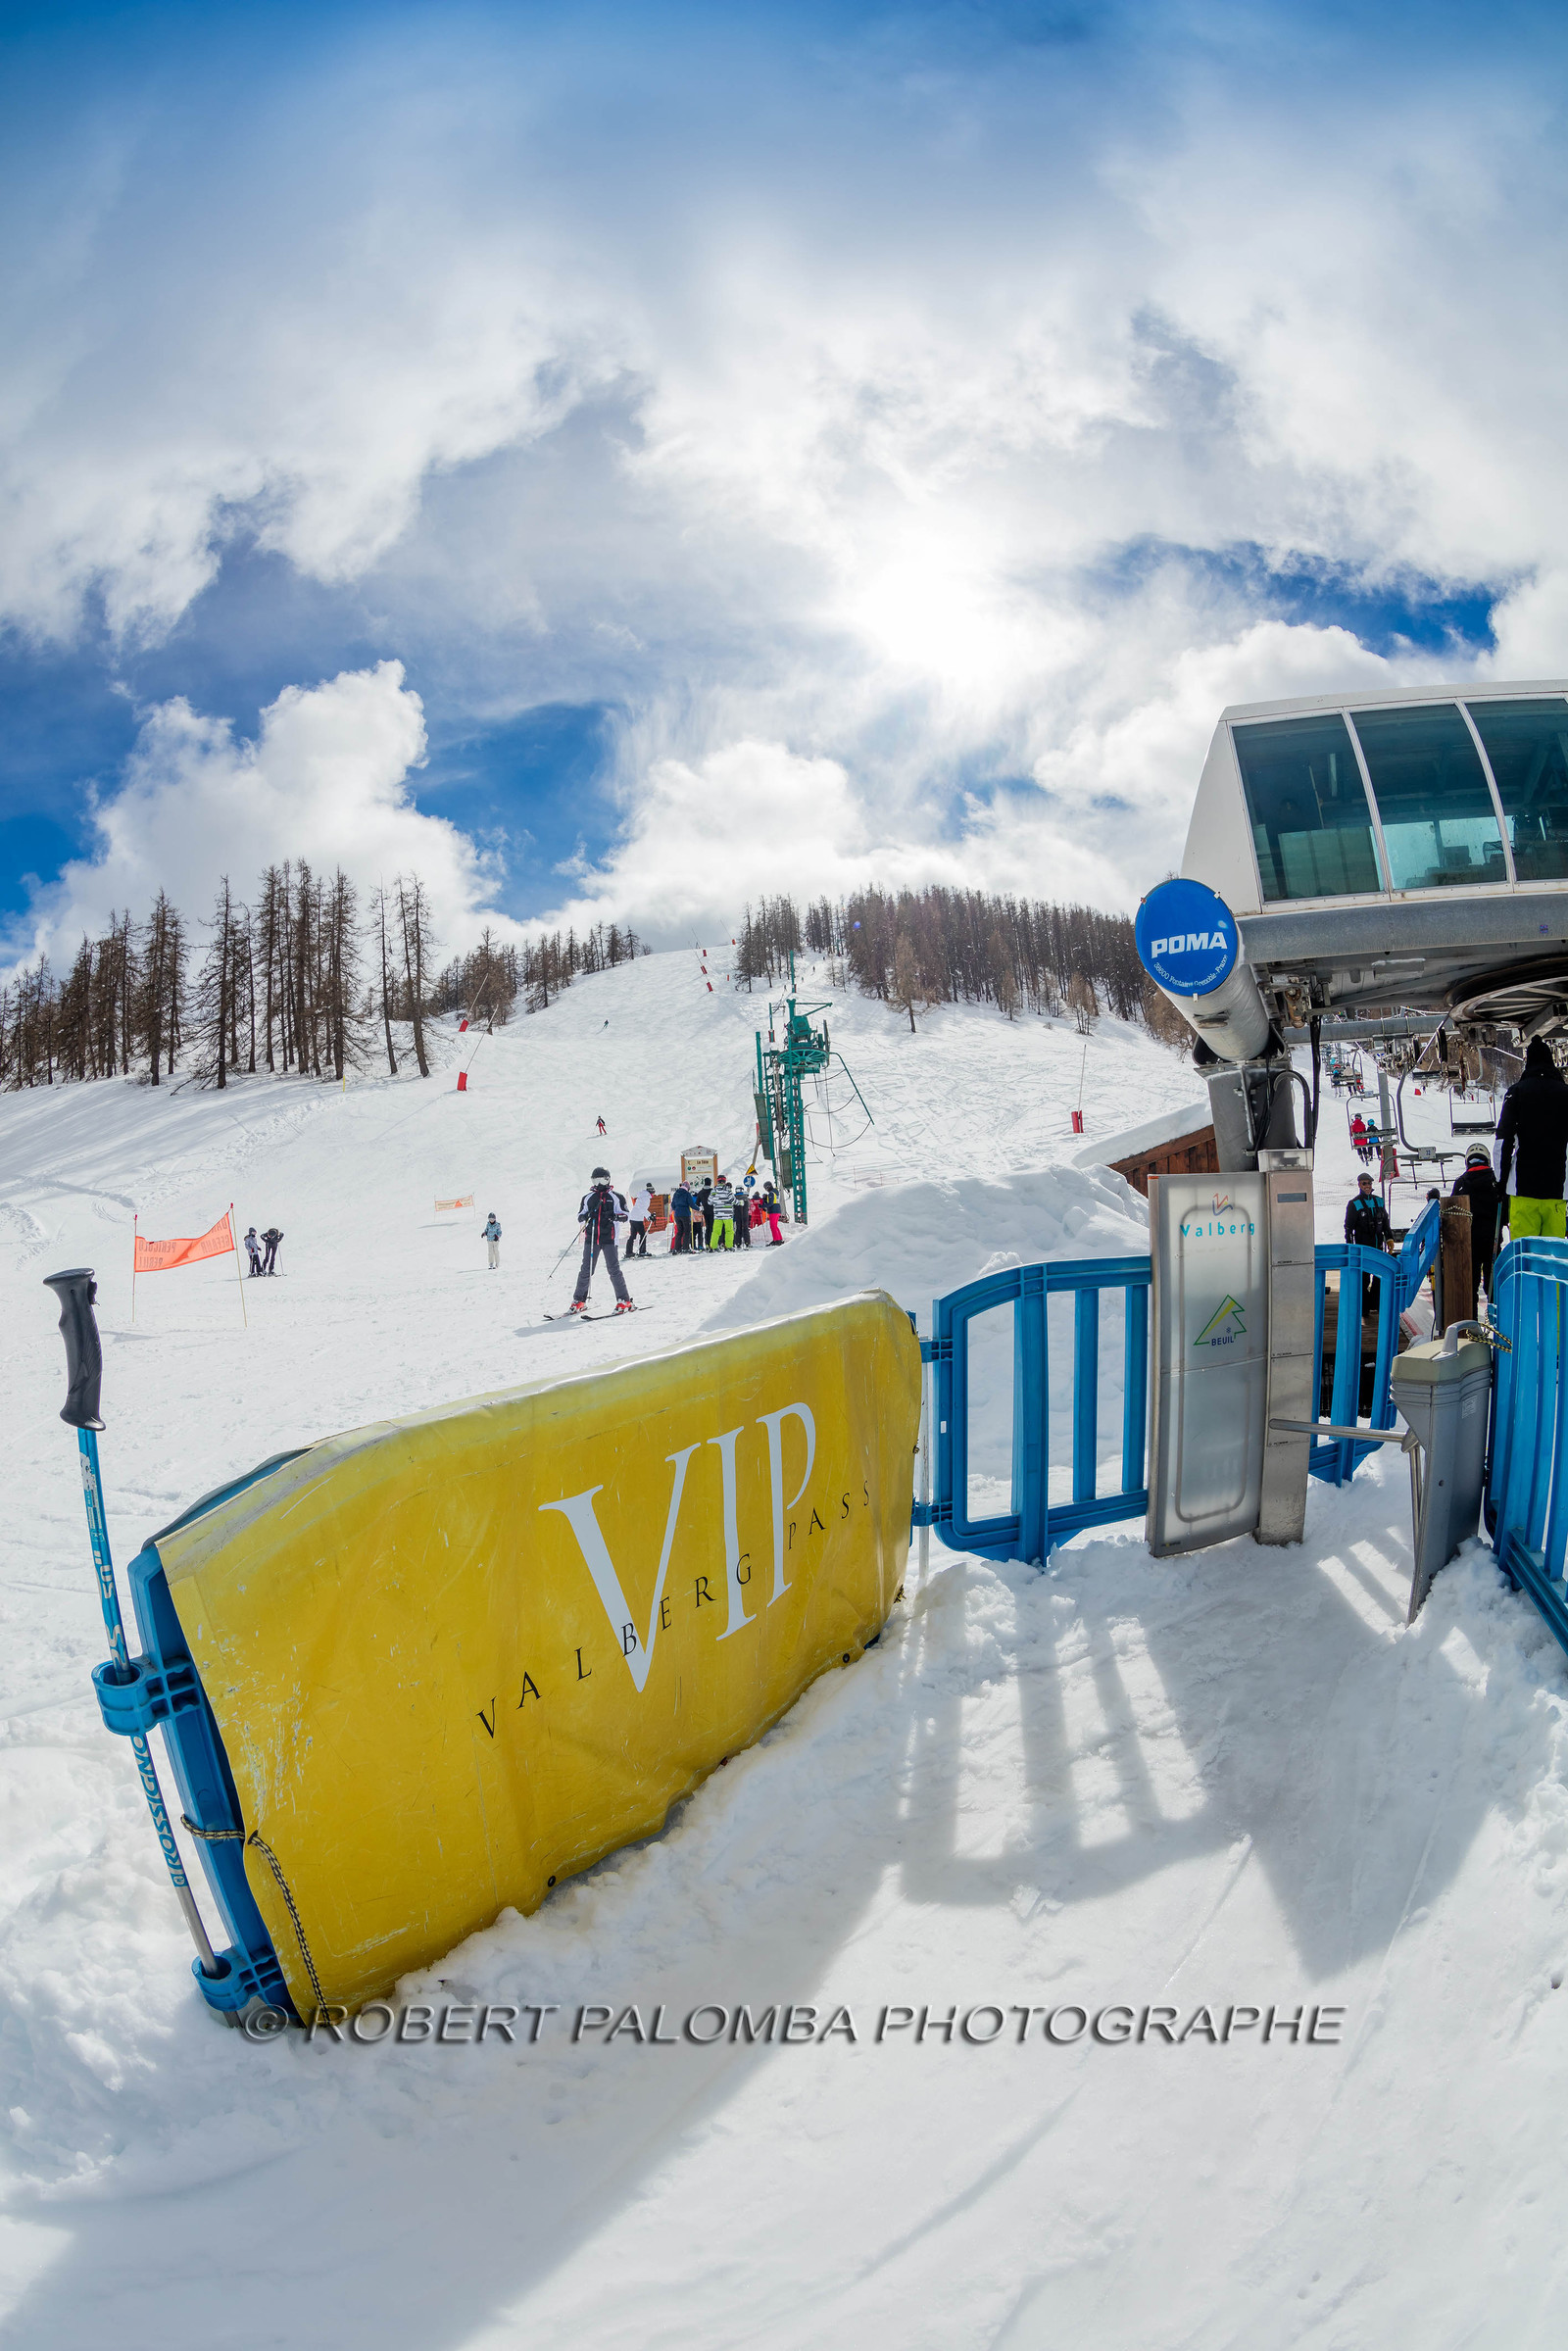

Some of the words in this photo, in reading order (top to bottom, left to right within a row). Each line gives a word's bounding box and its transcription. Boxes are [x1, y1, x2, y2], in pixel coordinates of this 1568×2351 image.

[1151, 932, 1227, 958] POMA
[1180, 1222, 1254, 1238] Valberg
[1211, 1336, 1235, 1347] BEUIL
[538, 1402, 816, 1693] VIP
[476, 1553, 753, 1739] VALBERG
[787, 1480, 871, 1550] PASS
[131, 1735, 182, 1870] ROSSIGNO
